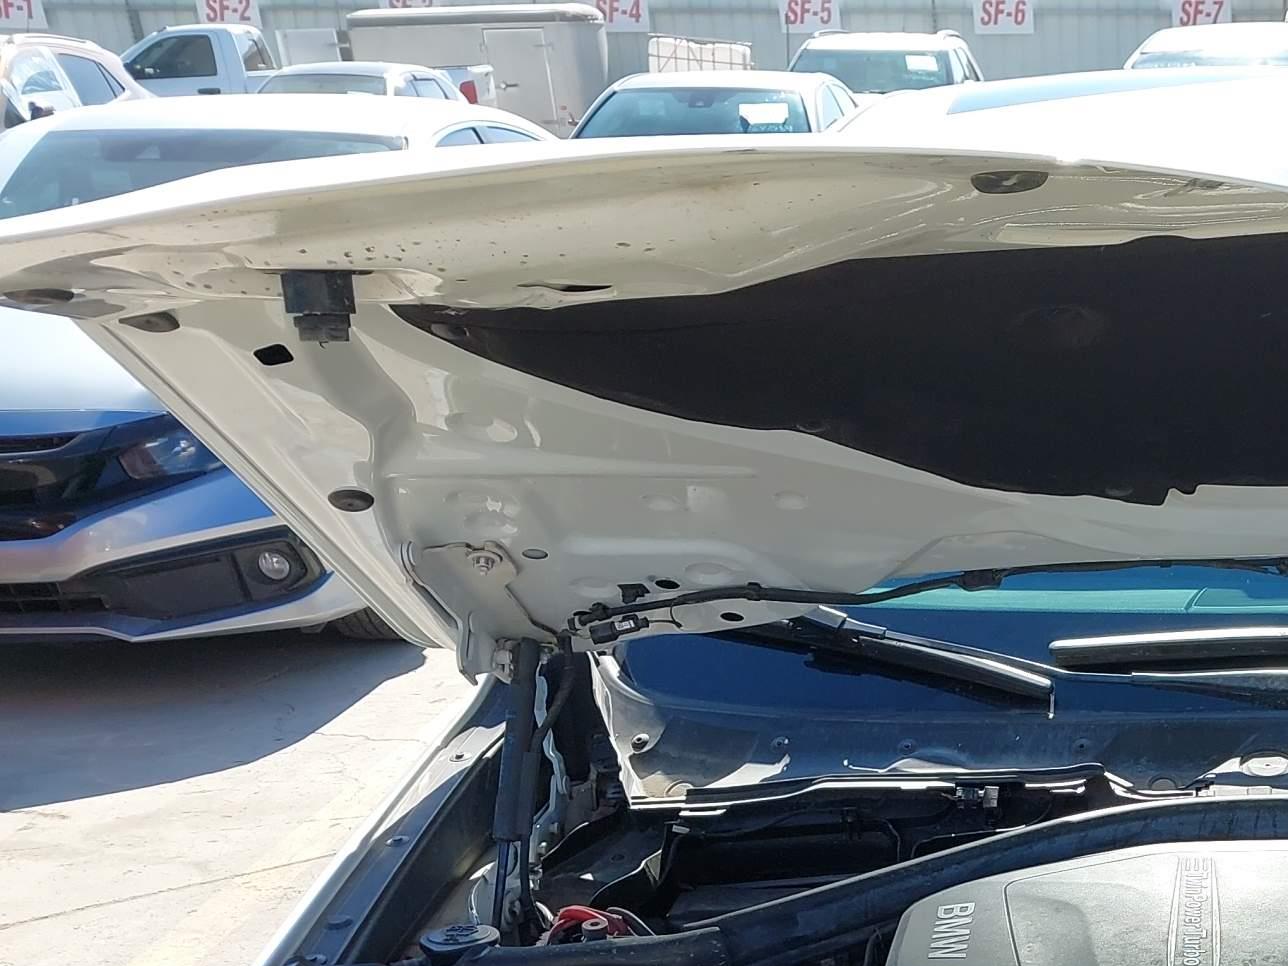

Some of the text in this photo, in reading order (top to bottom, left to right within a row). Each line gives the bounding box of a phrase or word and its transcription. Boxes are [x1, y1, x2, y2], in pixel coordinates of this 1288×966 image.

[0, 0, 34, 20] F-1
[206, 0, 251, 22] SF-2
[596, 0, 641, 23] SF-4
[786, 0, 832, 25] SF-5
[980, 0, 1027, 26] SF-6
[1180, 0, 1224, 25] SF-7
[927, 902, 976, 959] BMW
